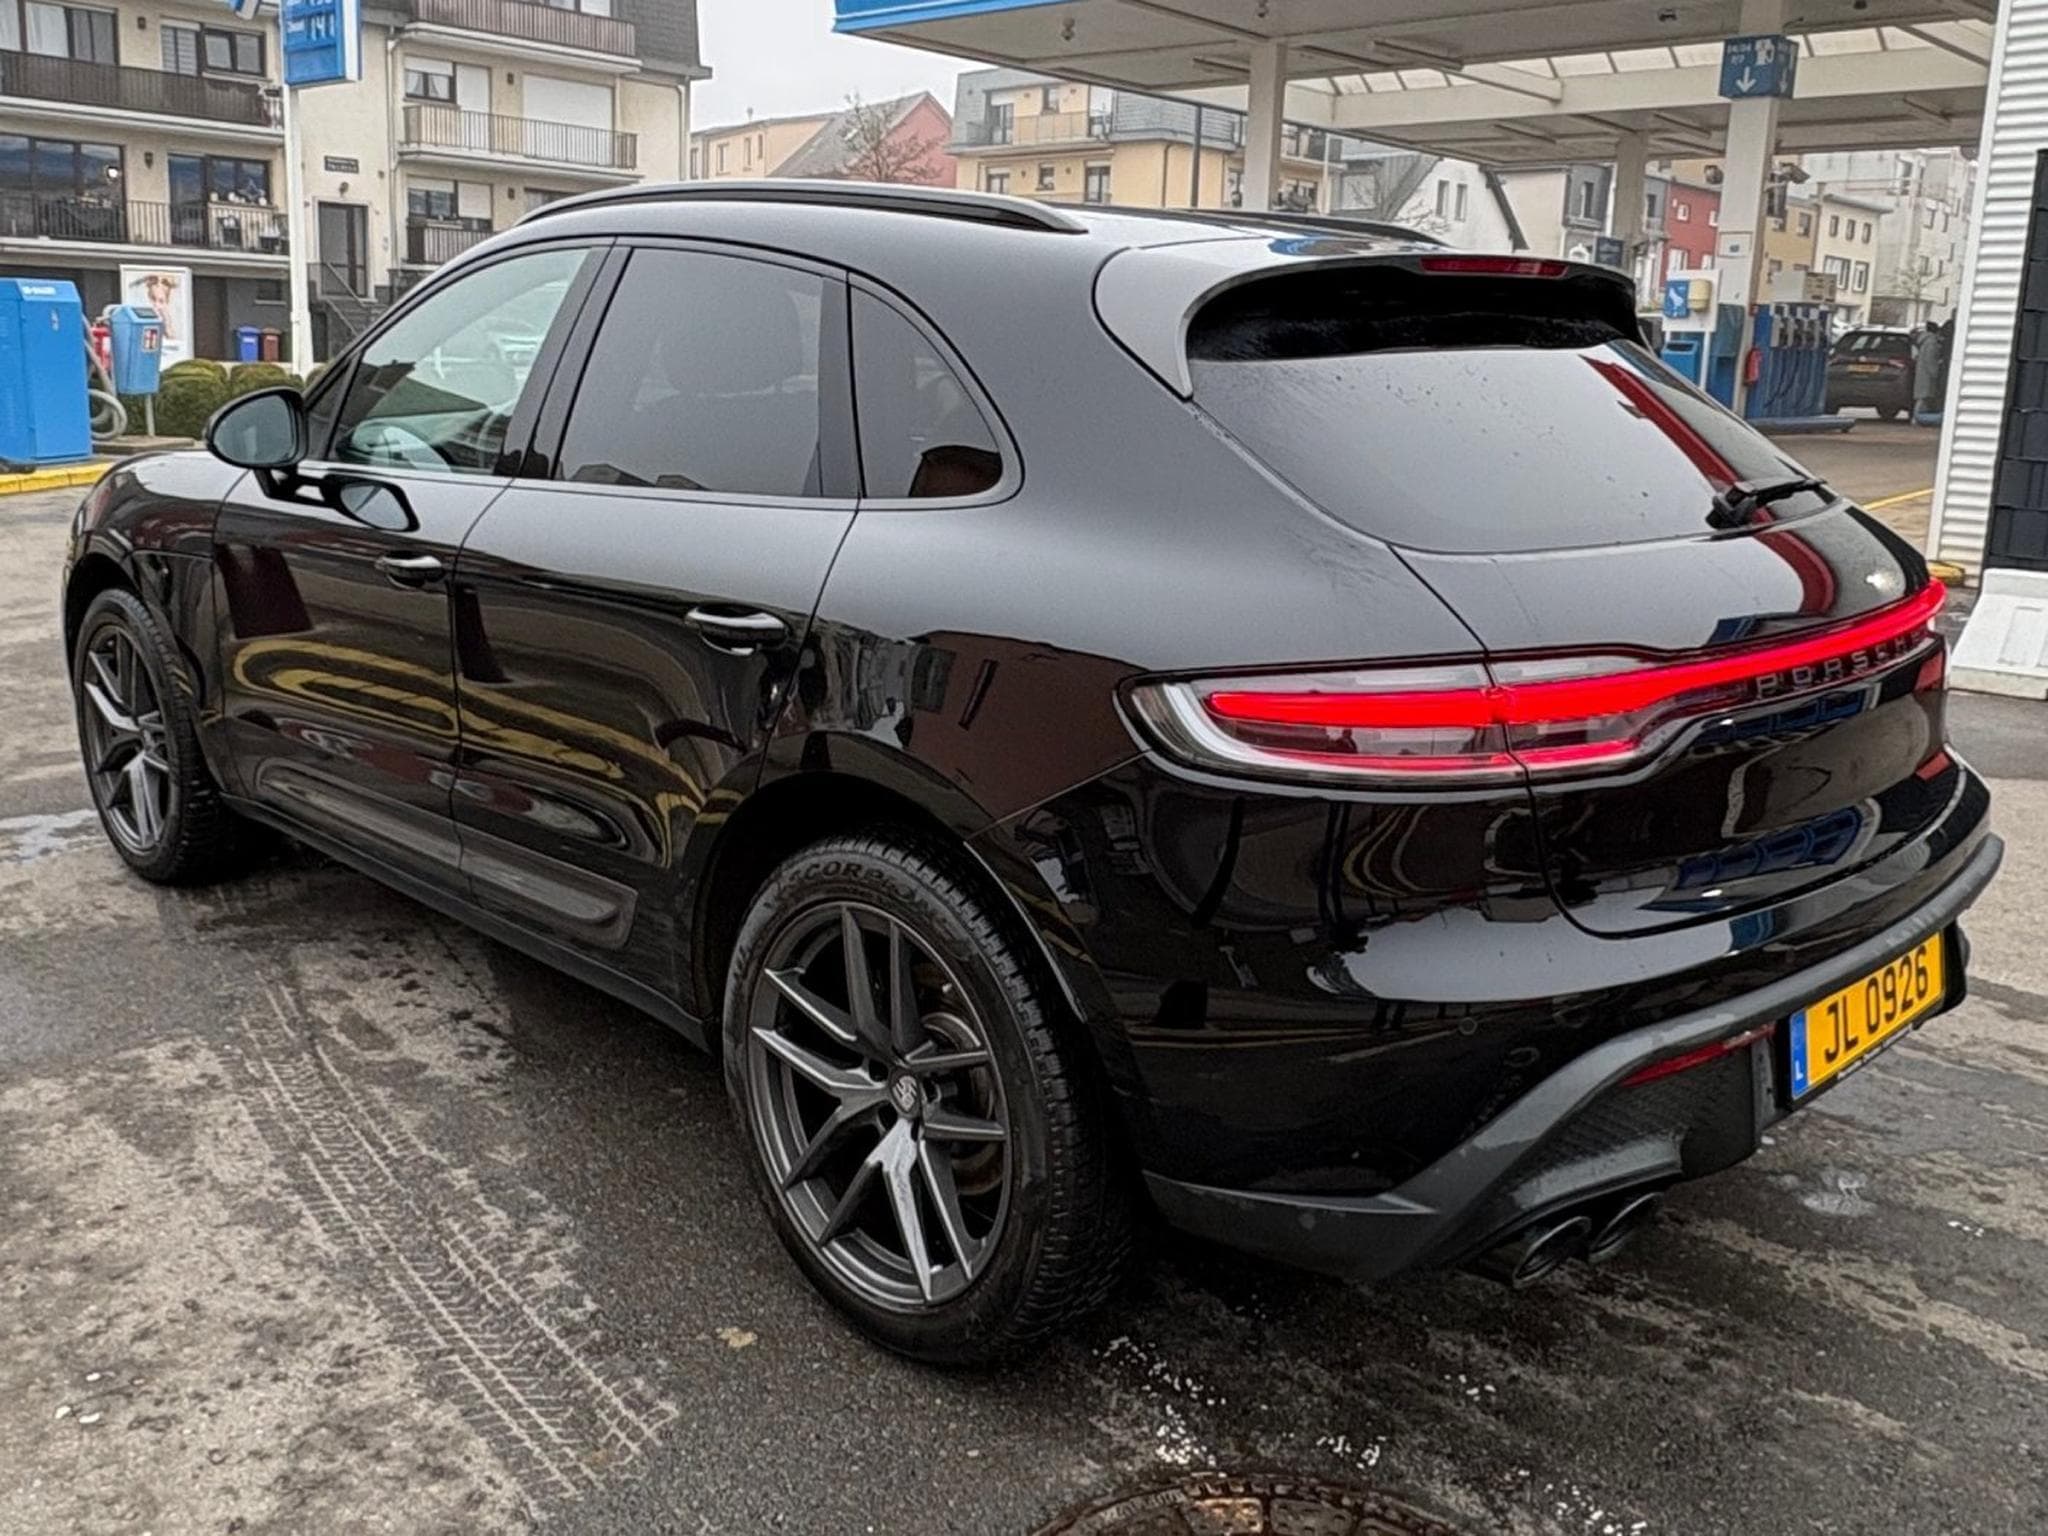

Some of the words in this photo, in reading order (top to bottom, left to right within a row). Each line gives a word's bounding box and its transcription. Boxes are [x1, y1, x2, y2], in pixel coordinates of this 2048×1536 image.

[1756, 630, 1922, 700] PORSCHE
[1825, 995, 1859, 1063] JL
[1865, 945, 1928, 1035] 0926
[1794, 1060, 1804, 1081] L
